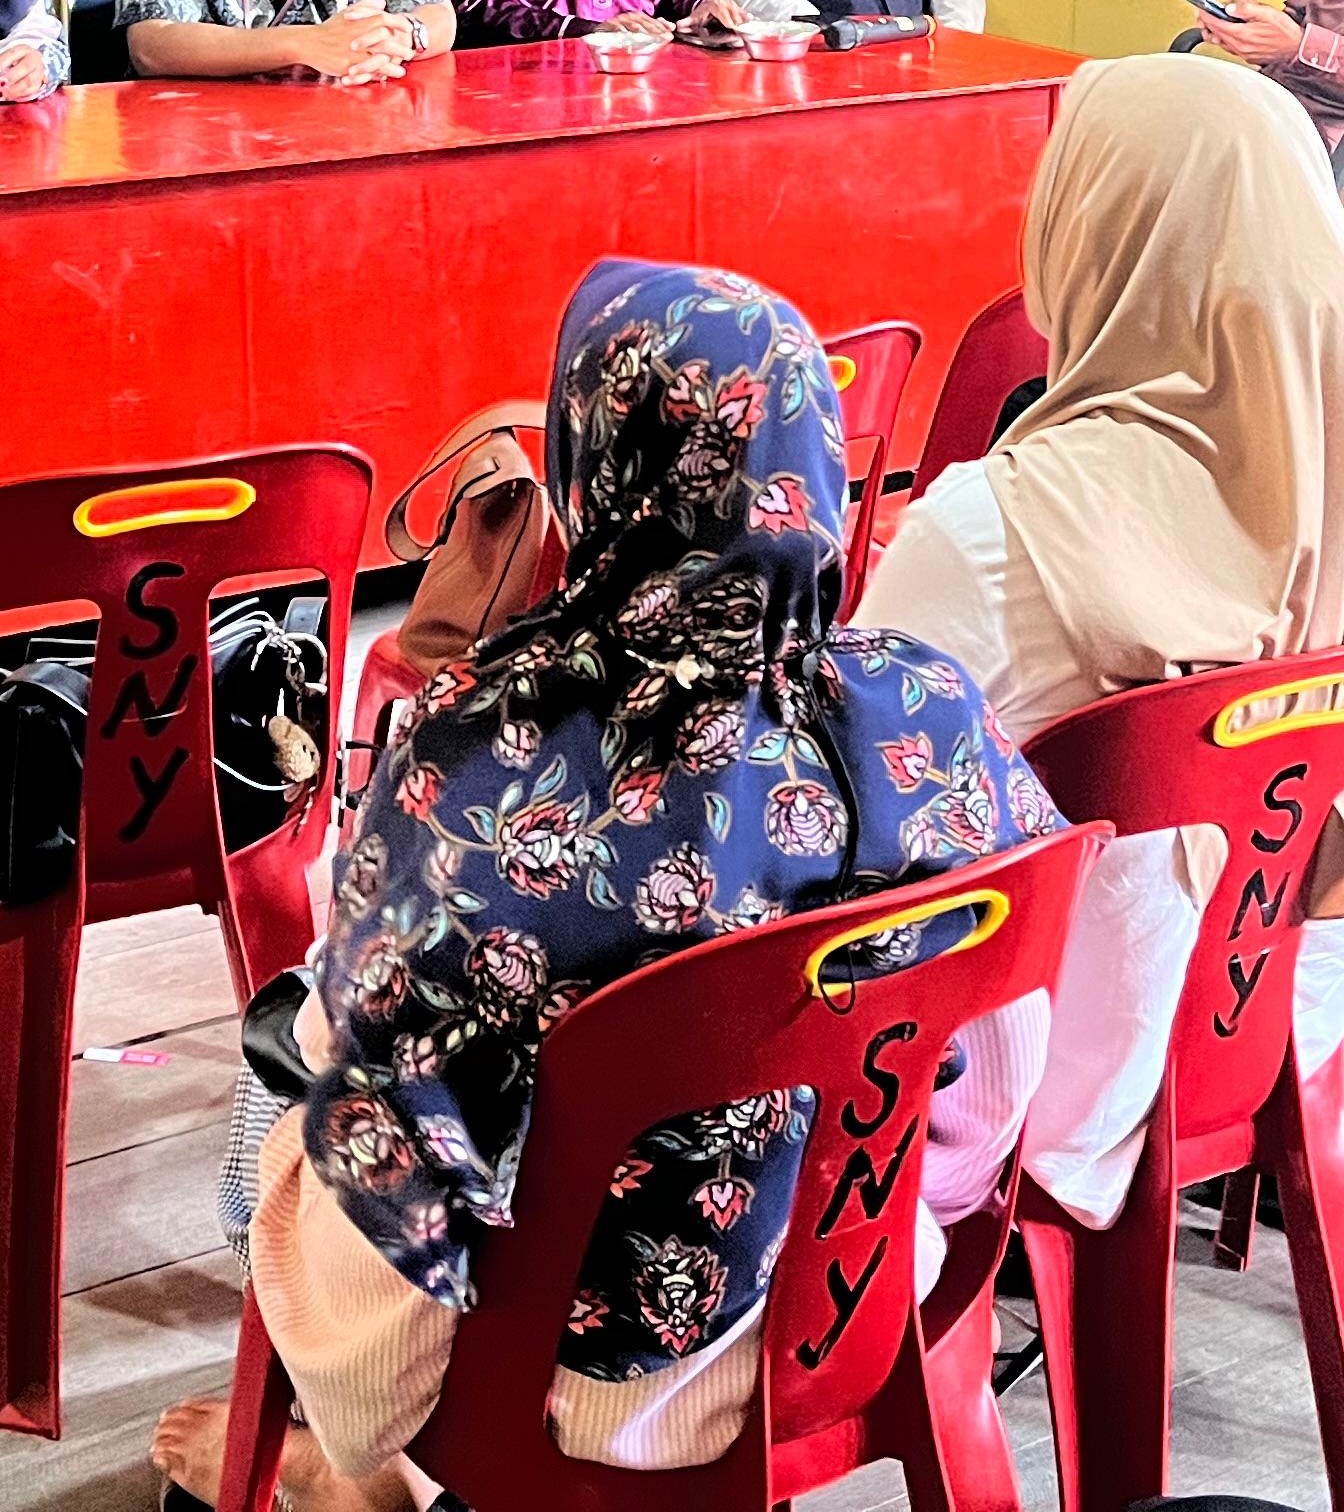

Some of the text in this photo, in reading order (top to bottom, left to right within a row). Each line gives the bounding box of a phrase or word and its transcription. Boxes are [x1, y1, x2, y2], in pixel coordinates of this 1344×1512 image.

[100, 561, 198, 843] SNY
[1214, 763, 1308, 1037] SNY
[795, 1022, 919, 1370] SNY
